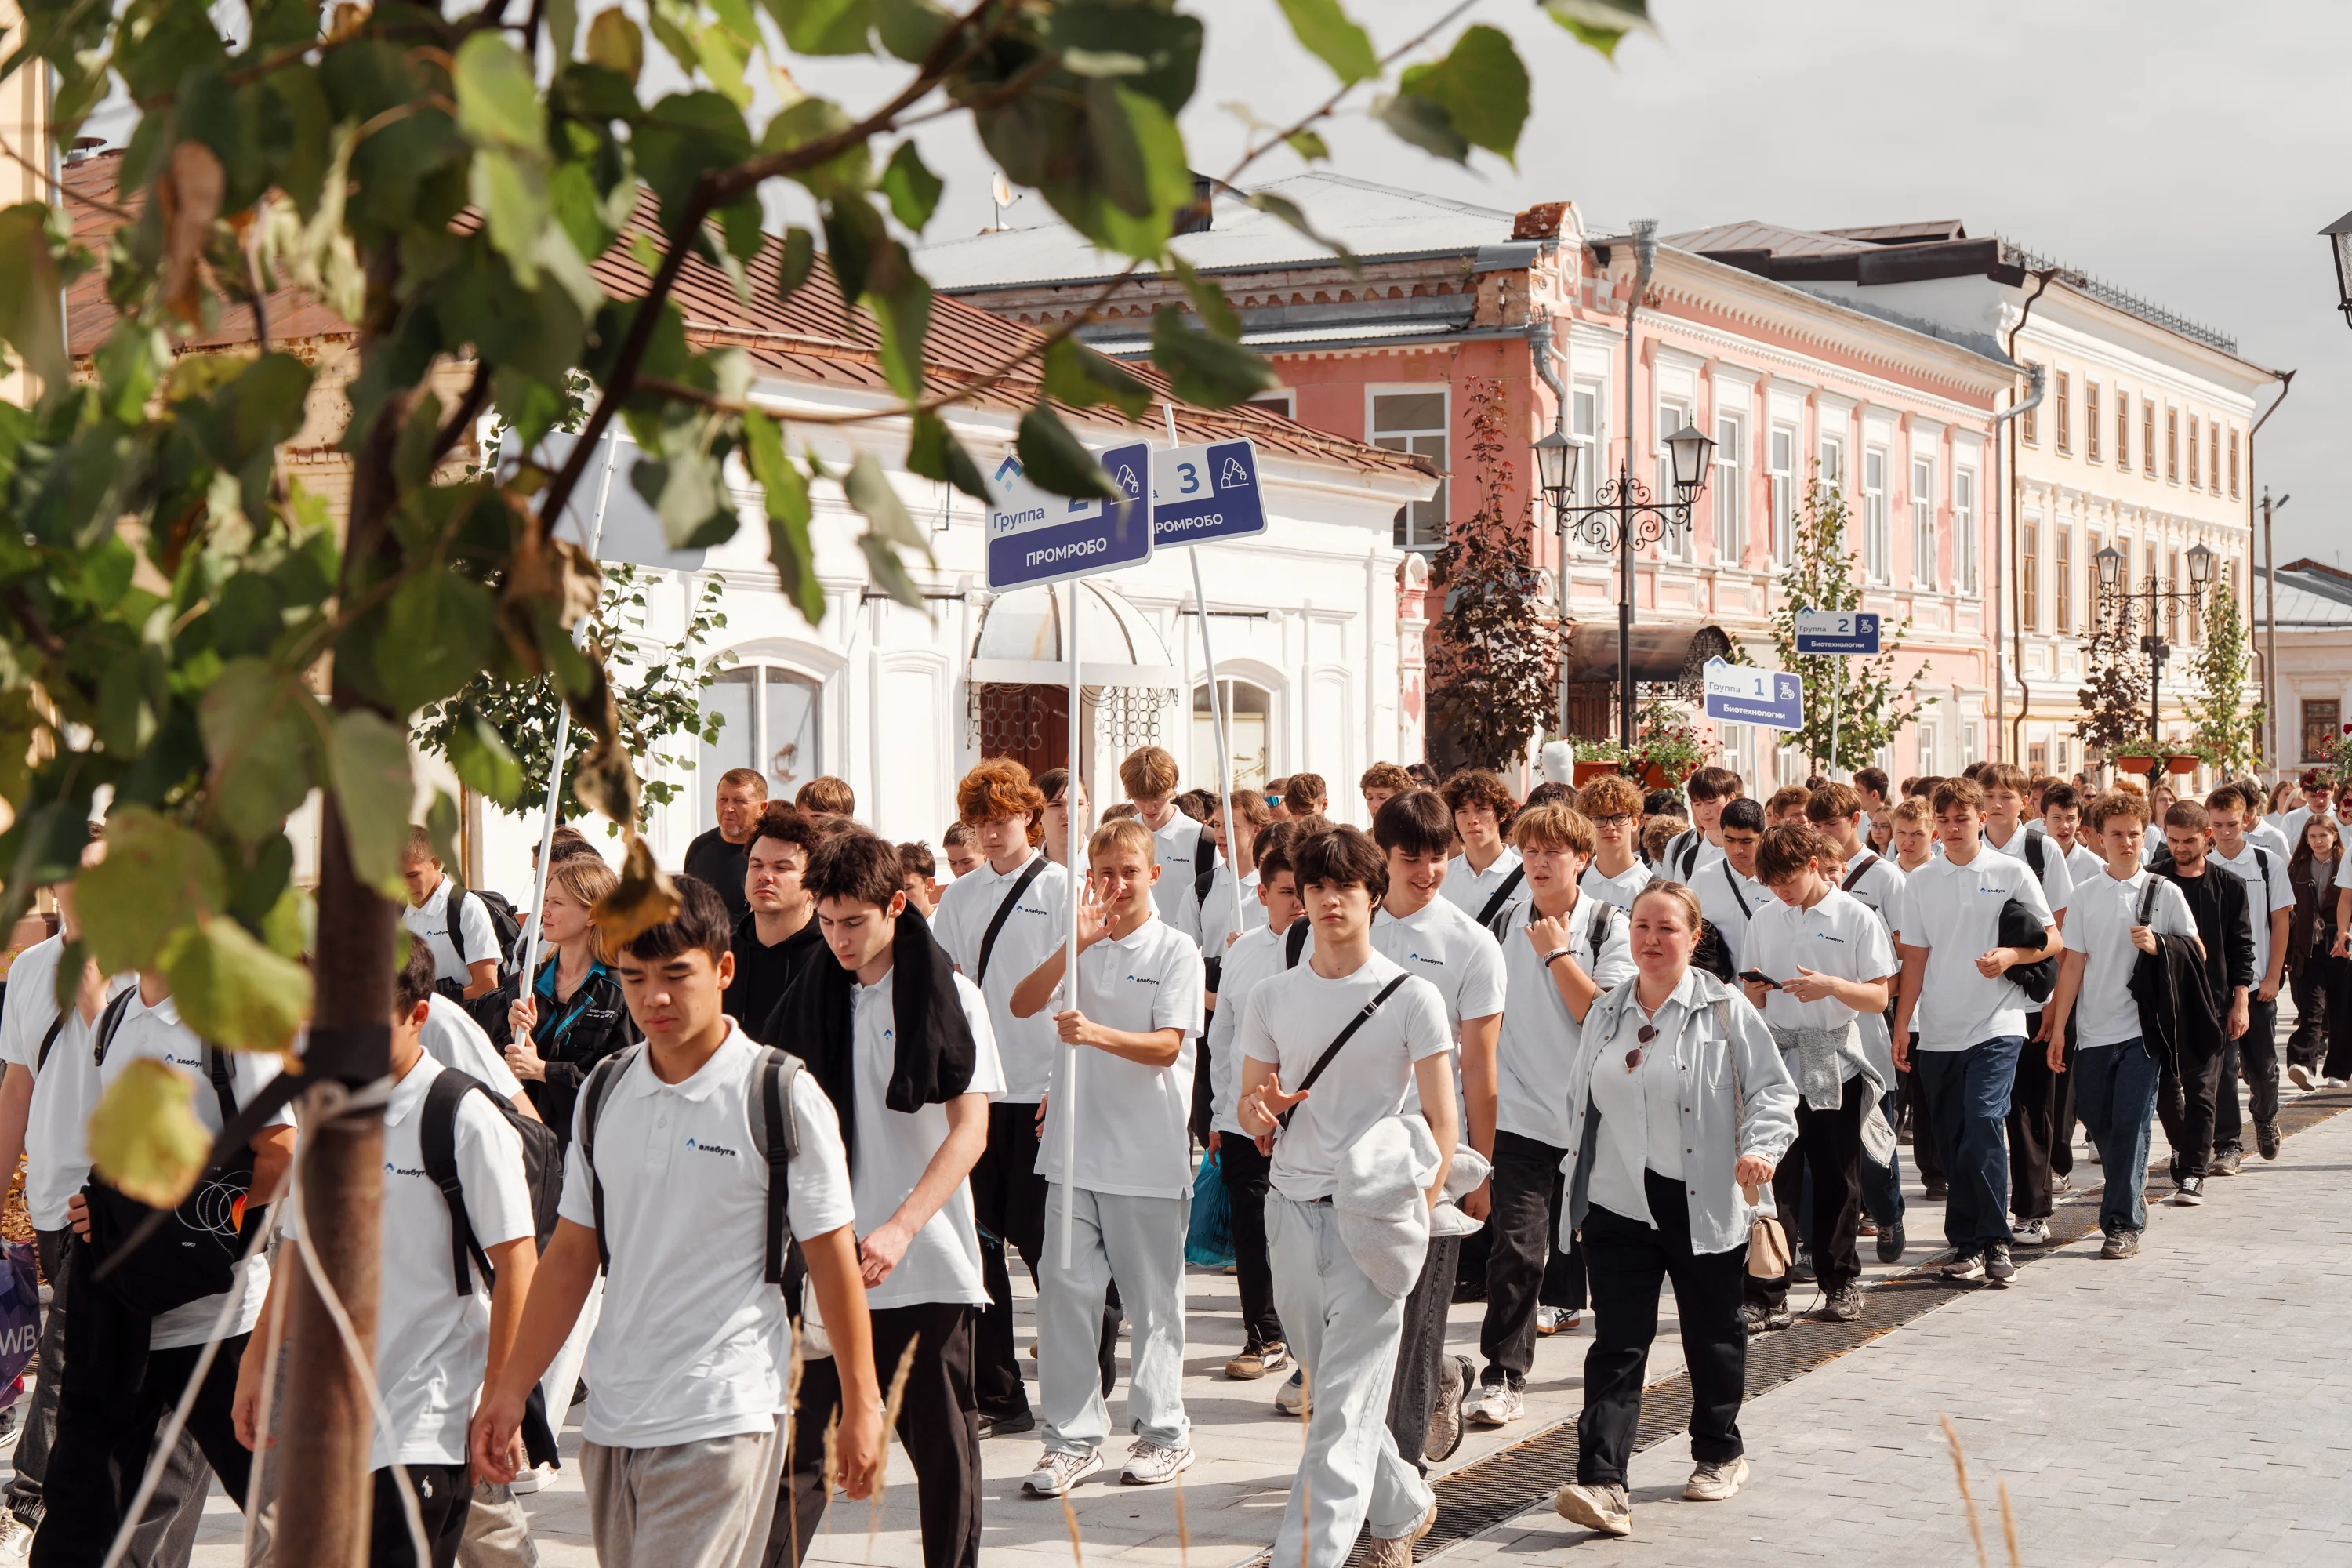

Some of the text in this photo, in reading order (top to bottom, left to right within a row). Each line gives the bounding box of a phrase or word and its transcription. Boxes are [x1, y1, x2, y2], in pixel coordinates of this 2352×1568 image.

[1177, 463, 1200, 494] 3
[994, 507, 1045, 532] Группа
[1154, 514, 1223, 534] РОМРОБО
[1026, 537, 1107, 567] ПРОМРОБО
[1838, 619, 1849, 633] 2
[1709, 678, 1764, 696] Группа 1
[1723, 703, 1786, 720] Биотехнологии
[1419, 957, 1443, 966] алабуга
[698, 1144, 736, 1156] алабуга
